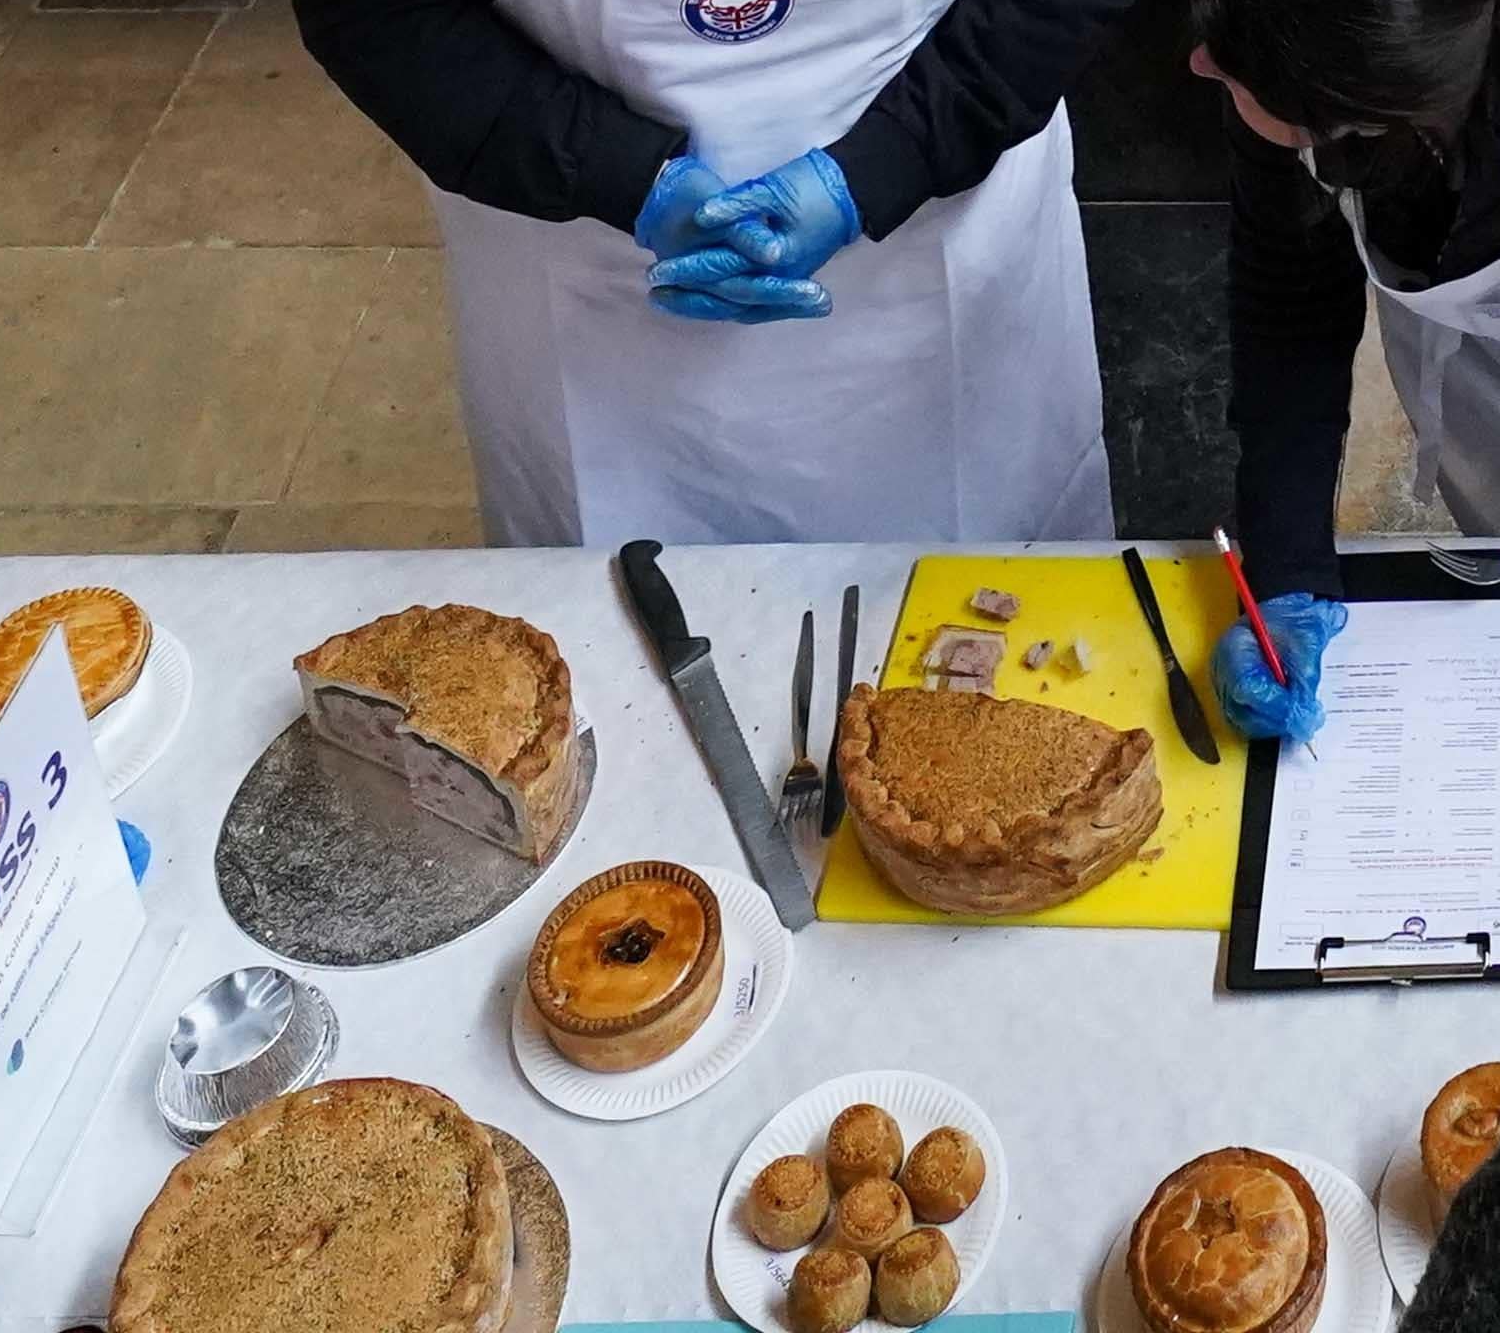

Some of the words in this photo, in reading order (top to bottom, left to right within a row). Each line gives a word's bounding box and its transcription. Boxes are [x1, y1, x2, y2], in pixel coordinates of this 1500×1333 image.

[40, 749, 68, 811] 3
[3, 910, 39, 969] College
[35, 853, 61, 906] Group
